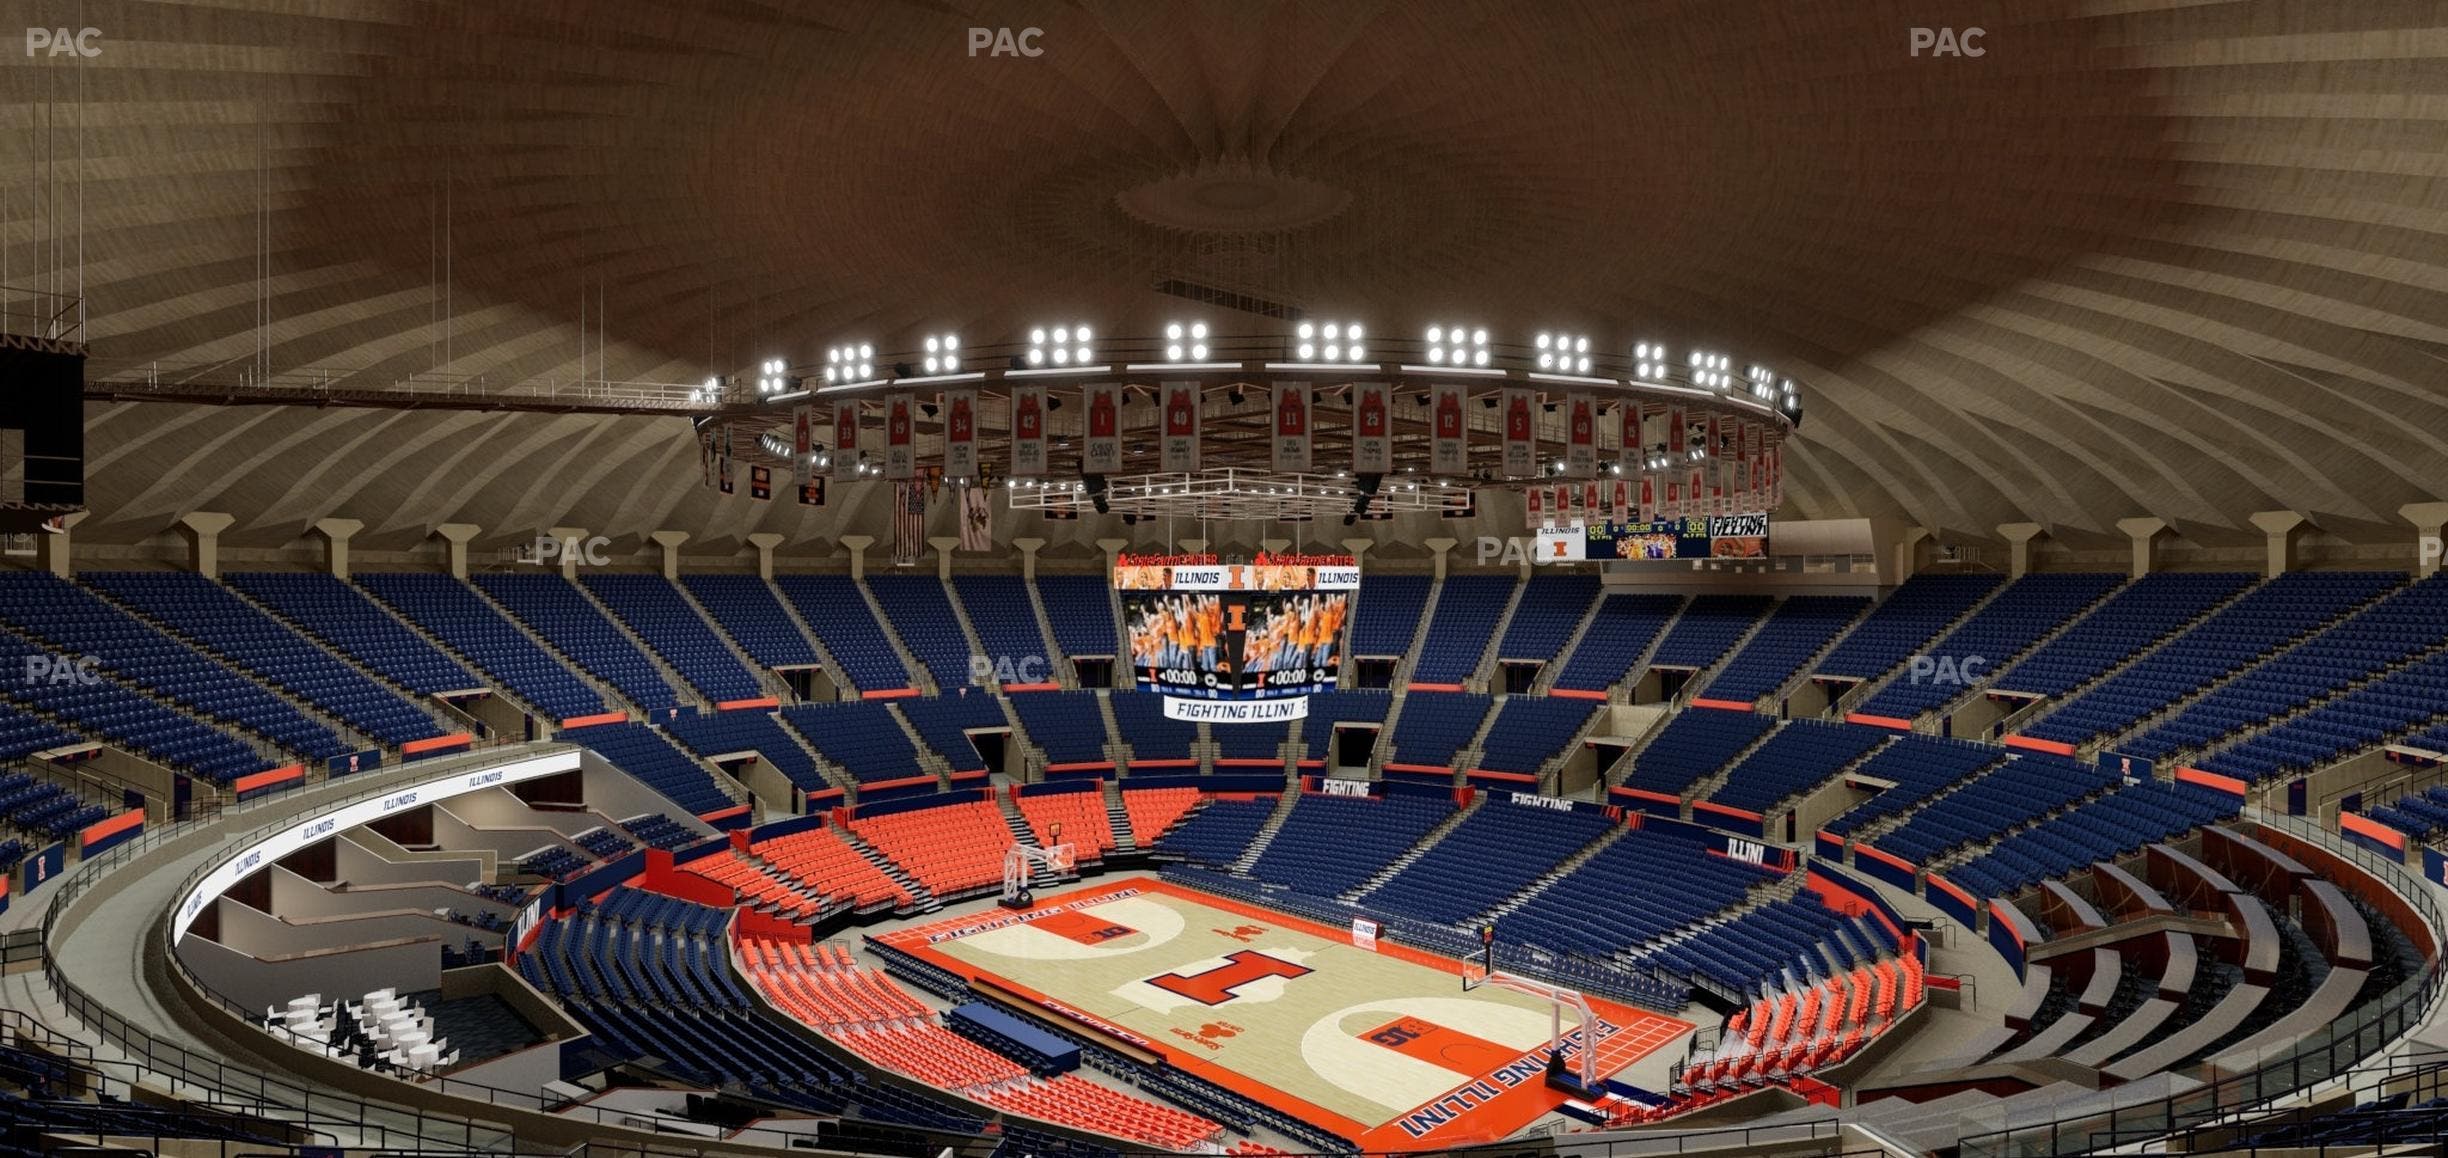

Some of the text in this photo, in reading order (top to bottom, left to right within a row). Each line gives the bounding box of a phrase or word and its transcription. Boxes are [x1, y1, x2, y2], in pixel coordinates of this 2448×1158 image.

[955, 418, 968, 433] 34
[1173, 412, 1187, 426] 40
[1285, 412, 1297, 426] 11
[1444, 415, 1455, 428] 12
[1713, 514, 1767, 528] FIGHTING
[1541, 526, 1581, 535] ILLINOIS
[1712, 525, 1767, 537] ILLINI
[1174, 571, 1220, 584] ILLINOIS
[1317, 572, 1359, 584] ILLINOIS
[1166, 668, 1198, 685] 00:00
[1276, 668, 1307, 685] 00:00
[1177, 702, 1249, 719] FIGHTING
[1251, 702, 1295, 718] ILLINI
[469, 771, 503, 788] ILLINOIS
[1322, 778, 1371, 798] FIGHTING
[383, 792, 418, 811] ILLINOIS
[1511, 792, 1574, 812] FIGHTING
[303, 817, 335, 841] ILLINOIS
[1727, 837, 1765, 865] ILLINI
[234, 850, 262, 877] ILLINOIS
[1398, 1079, 1504, 1139] ILLINI
